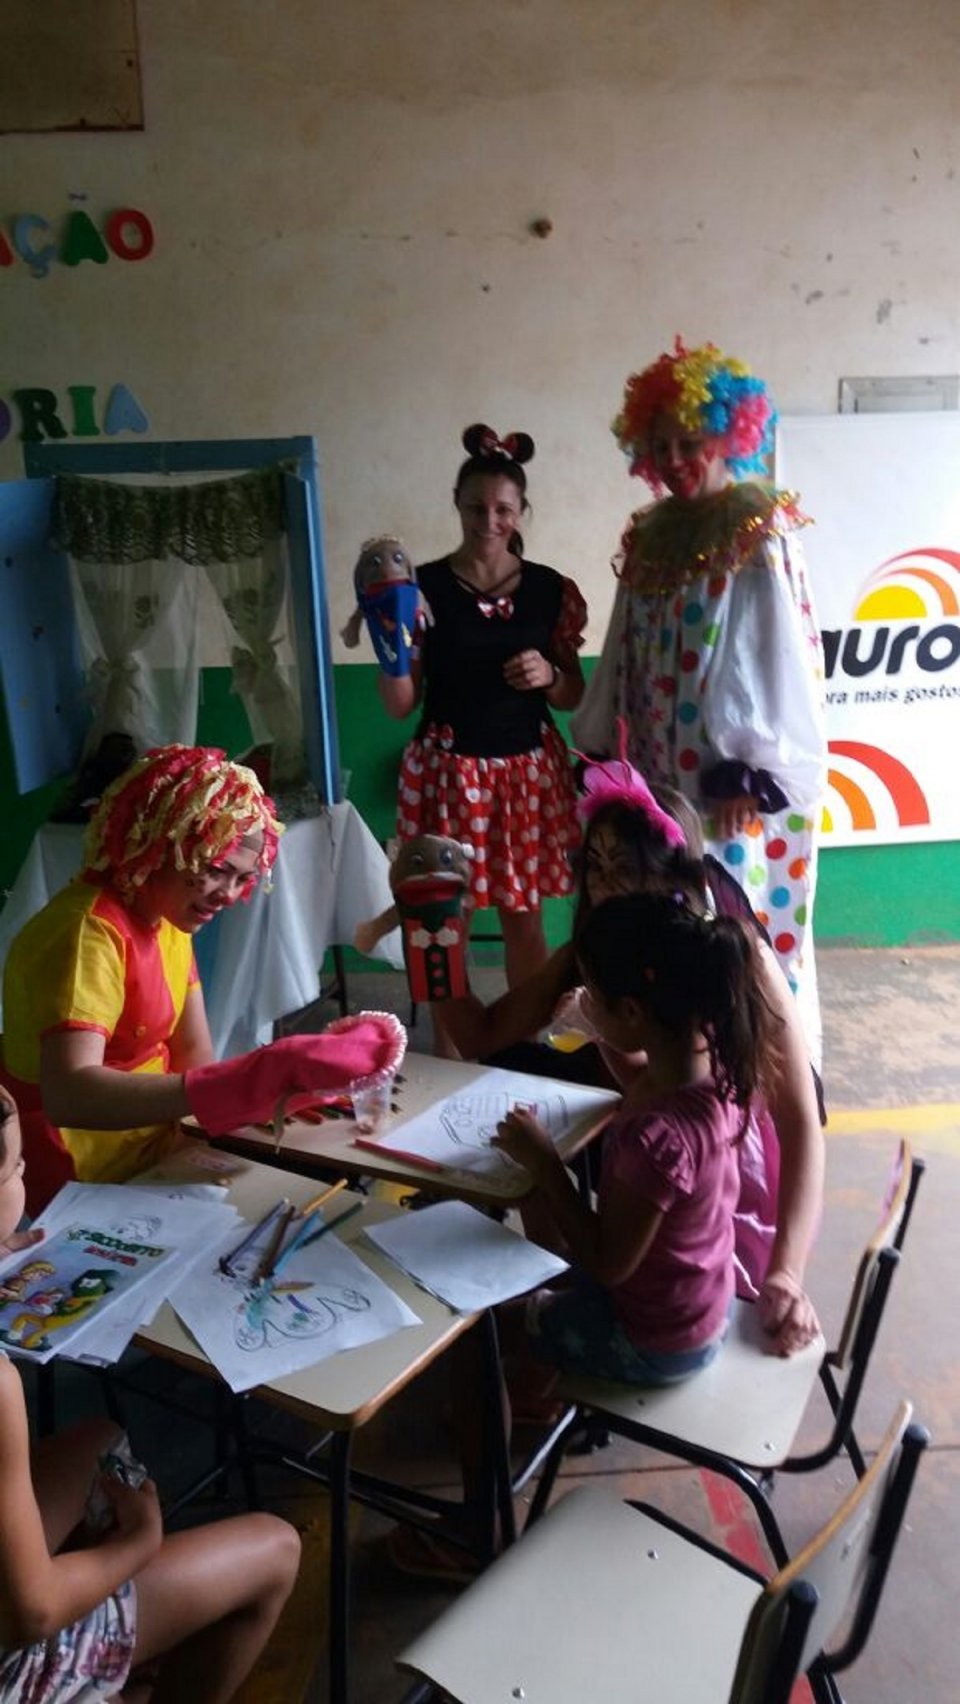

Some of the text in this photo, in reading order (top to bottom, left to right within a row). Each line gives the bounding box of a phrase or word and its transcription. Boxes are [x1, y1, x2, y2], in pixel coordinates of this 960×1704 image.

[0, 193, 154, 279] ÇÃO
[0, 383, 150, 442] RIA
[826, 684, 960, 704] ra mais gosto
